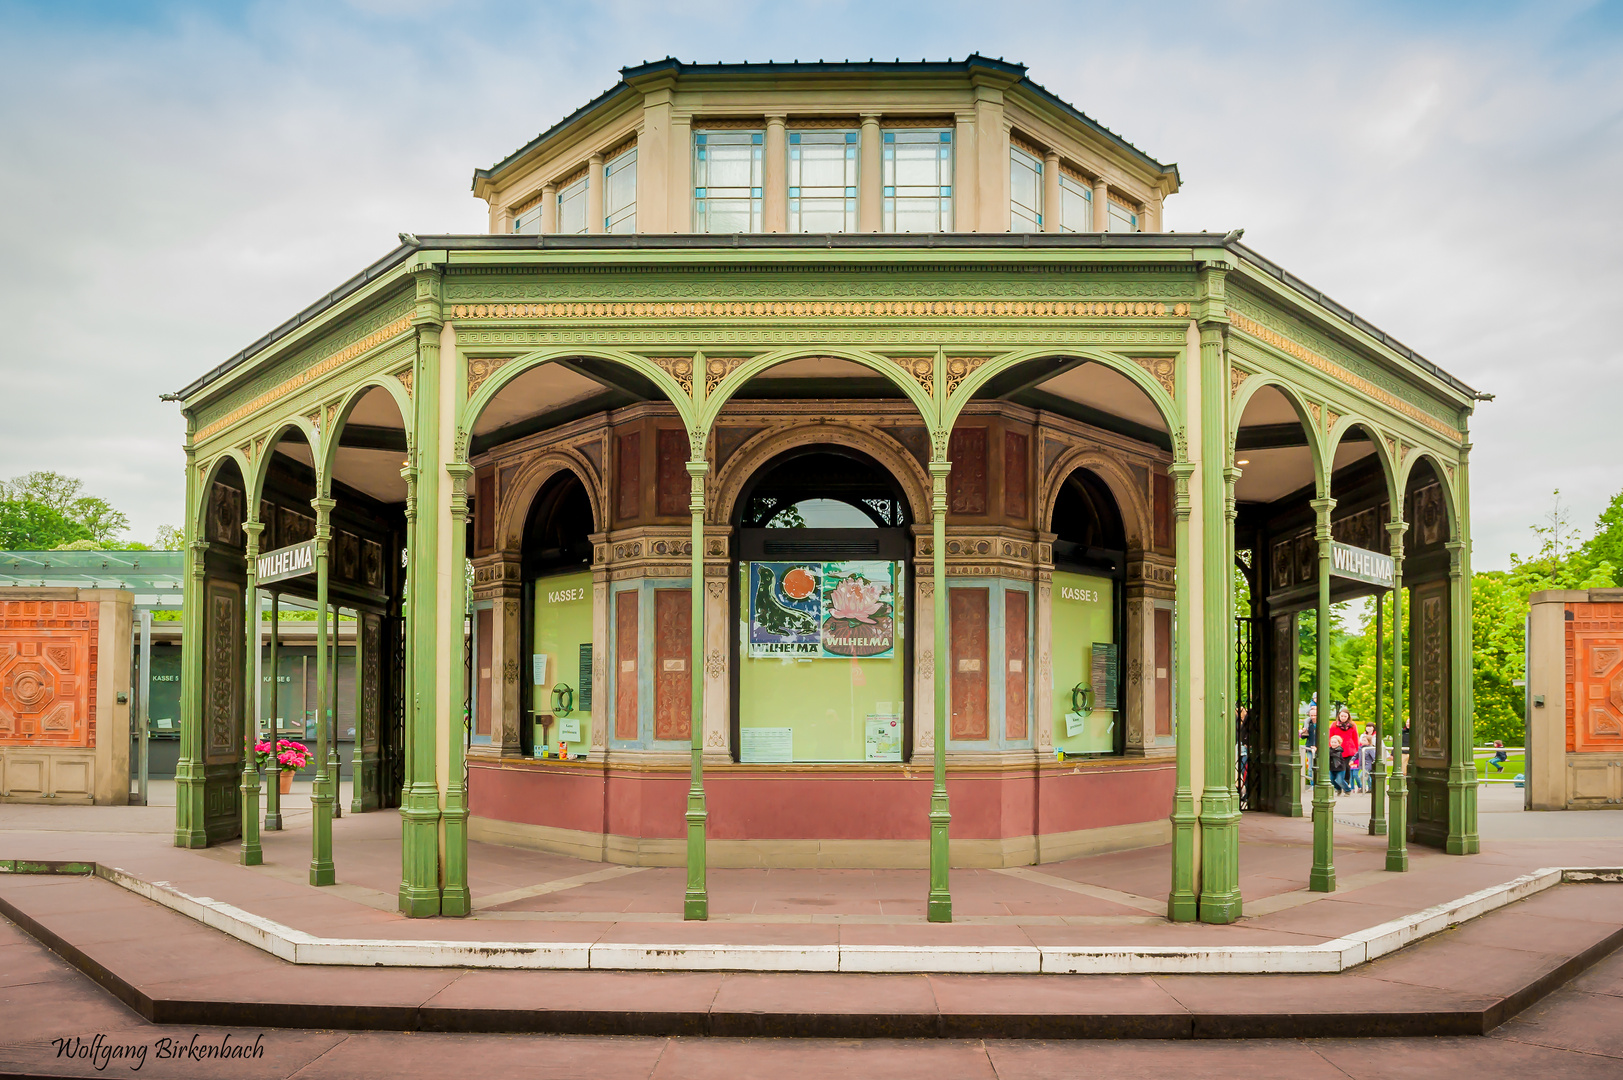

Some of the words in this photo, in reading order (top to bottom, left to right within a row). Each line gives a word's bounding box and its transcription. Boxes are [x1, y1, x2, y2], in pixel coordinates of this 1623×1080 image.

[258, 545, 313, 579] WILHELMA
[1333, 546, 1393, 581] WILHELMA
[548, 588, 577, 604] KASSE
[578, 587, 584, 600] 2
[1061, 586, 1091, 602] KASSE
[1092, 591, 1098, 603] 3
[826, 637, 890, 647] WILHELMA
